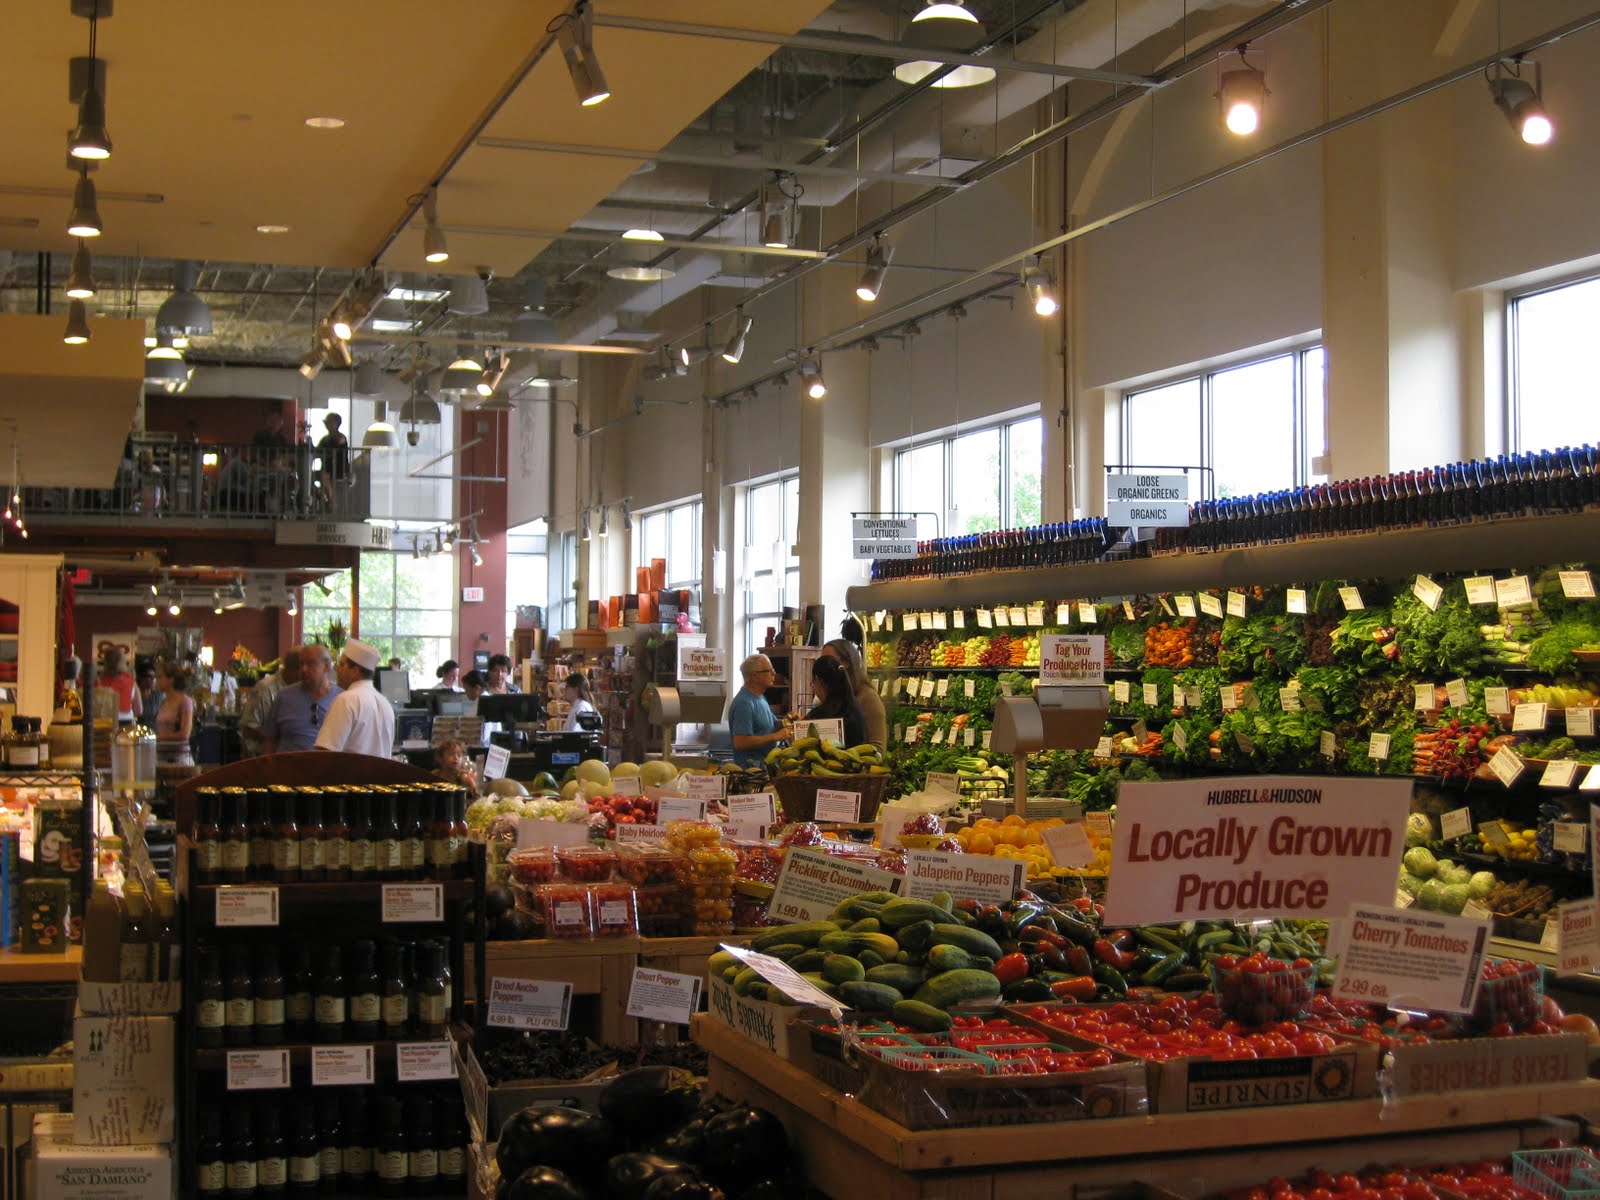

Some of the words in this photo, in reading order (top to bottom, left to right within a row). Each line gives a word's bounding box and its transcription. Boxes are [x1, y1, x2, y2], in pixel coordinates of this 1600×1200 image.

[1137, 476, 1159, 487] LOOSE
[1117, 487, 1150, 499] ORGANIC
[1151, 488, 1179, 500] GREENS
[1130, 508, 1167, 520] ORGANICS
[863, 520, 907, 529] CONVENTIONAL
[372, 527, 388, 544] H&H
[871, 529, 900, 538] LETTUCES
[860, 545, 876, 554] BABY
[876, 545, 912, 554] VEGETABLES
[1055, 644, 1071, 658] Tag
[1072, 644, 1091, 655] Your
[690, 654, 702, 663] Tag
[702, 654, 716, 662] Your
[1043, 658, 1080, 671] Produce
[1081, 659, 1101, 670] Here
[683, 663, 707, 671] Produce
[1207, 789, 1323, 806] HUBBELL&HUDSON
[619, 826, 637, 838] Baby
[722, 826, 738, 837] Pear
[1127, 817, 1259, 865] Locally
[1268, 815, 1393, 858] Grown
[828, 861, 847, 872] LOCALLY
[788, 859, 829, 884] Pickling
[829, 870, 888, 892] Cucumbers
[913, 862, 963, 882] Jalapeño
[965, 867, 1010, 886] Peppers
[1175, 871, 1330, 913] Produce
[776, 903, 799, 918] 1.99
[799, 905, 811, 922] lb.
[1562, 914, 1592, 933] Green
[1352, 920, 1401, 949] Cherry
[1404, 927, 1470, 954] Tomatoes
[636, 970, 656, 982] Ghost
[656, 973, 681, 986] Pepper
[494, 980, 515, 990] Dried
[515, 981, 539, 993] Ancho
[1339, 977, 1370, 996] 2.99
[1371, 983, 1389, 998] ea.
[494, 990, 523, 1003] Peppers
[489, 1015, 506, 1024] 4.99
[526, 1017, 541, 1026] PLU
[541, 1018, 559, 1027] 4715
[1409, 1057, 1503, 1092] PEACHES
[1512, 1054, 1570, 1083] TEXAS
[1191, 1079, 1307, 1106] SUNRIPE
[102, 1165, 145, 1174] AGRICOLA
